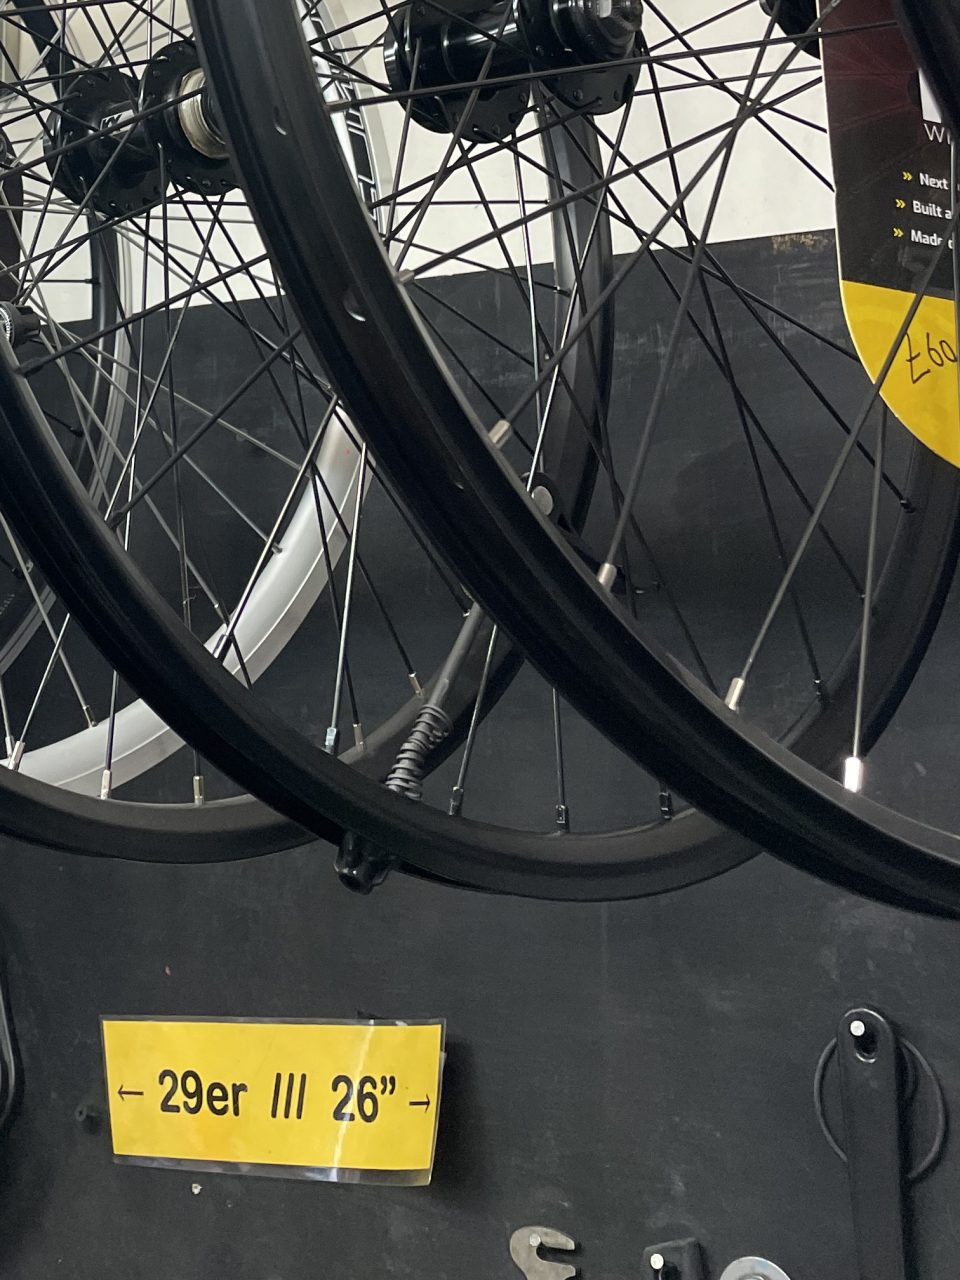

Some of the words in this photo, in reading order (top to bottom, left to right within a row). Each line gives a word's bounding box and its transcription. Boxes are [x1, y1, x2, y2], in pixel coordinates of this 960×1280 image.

[919, 172, 949, 191] Next
[912, 199, 943, 218] Built
[904, 331, 958, 385] £60
[158, 1069, 248, 1117] 29er
